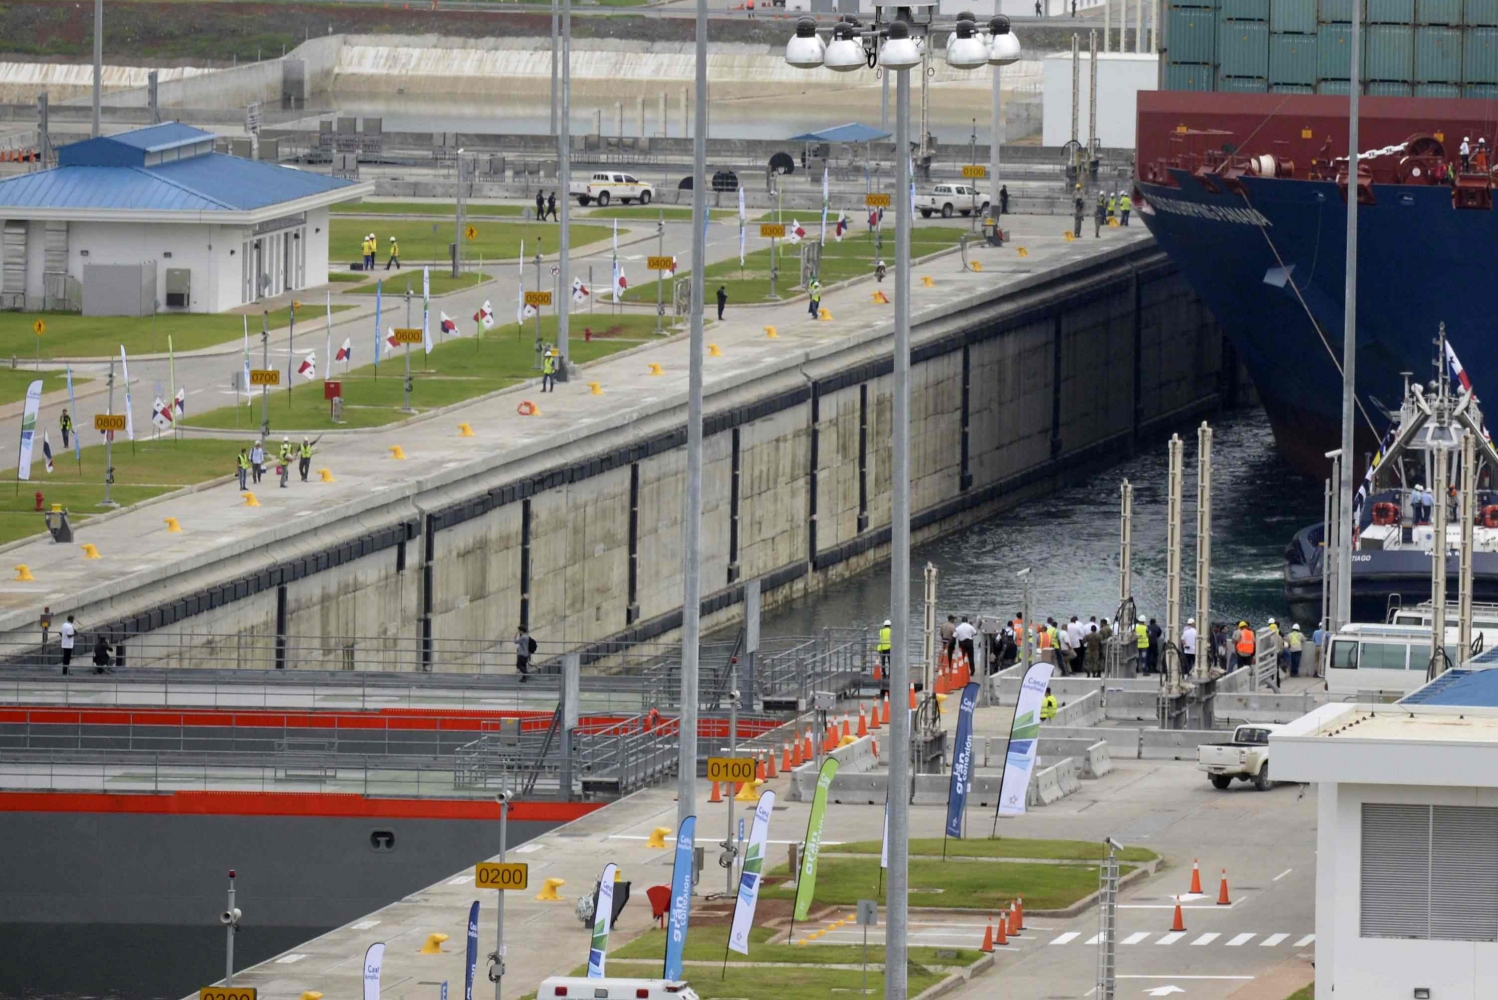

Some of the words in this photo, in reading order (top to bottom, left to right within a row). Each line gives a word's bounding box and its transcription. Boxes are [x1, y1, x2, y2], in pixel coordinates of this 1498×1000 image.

[867, 196, 889, 205] 0200
[762, 226, 784, 236] 0300
[648, 259, 673, 269] 0400
[526, 294, 550, 304] 0500
[395, 332, 421, 342] 0600
[252, 373, 278, 383] 0700
[96, 417, 123, 428] 0800
[1028, 677, 1046, 690] Canal
[711, 763, 752, 778] 0100
[955, 752, 966, 795] gran
[479, 868, 523, 885] 0200
[673, 896, 684, 943] gran
